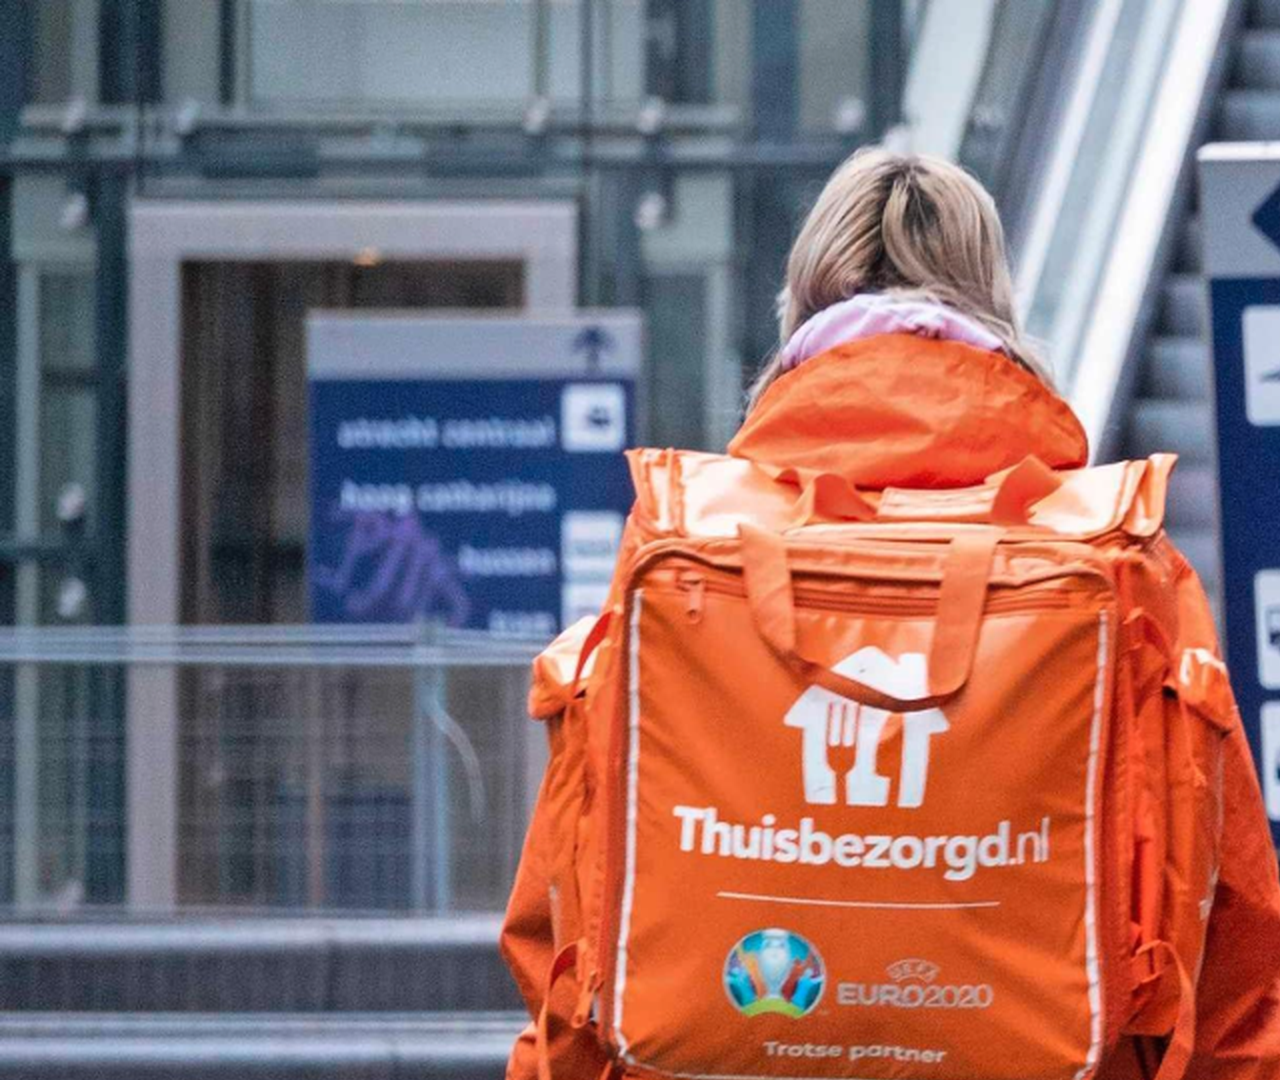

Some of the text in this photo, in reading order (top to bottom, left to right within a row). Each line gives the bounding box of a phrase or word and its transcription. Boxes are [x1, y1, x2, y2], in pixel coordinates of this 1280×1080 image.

[340, 480, 412, 517] hoog
[672, 805, 1050, 881] Thuisbezorgd.nl
[836, 983, 995, 1008] EURO2020
[763, 1040, 947, 1063] Trotse partner
